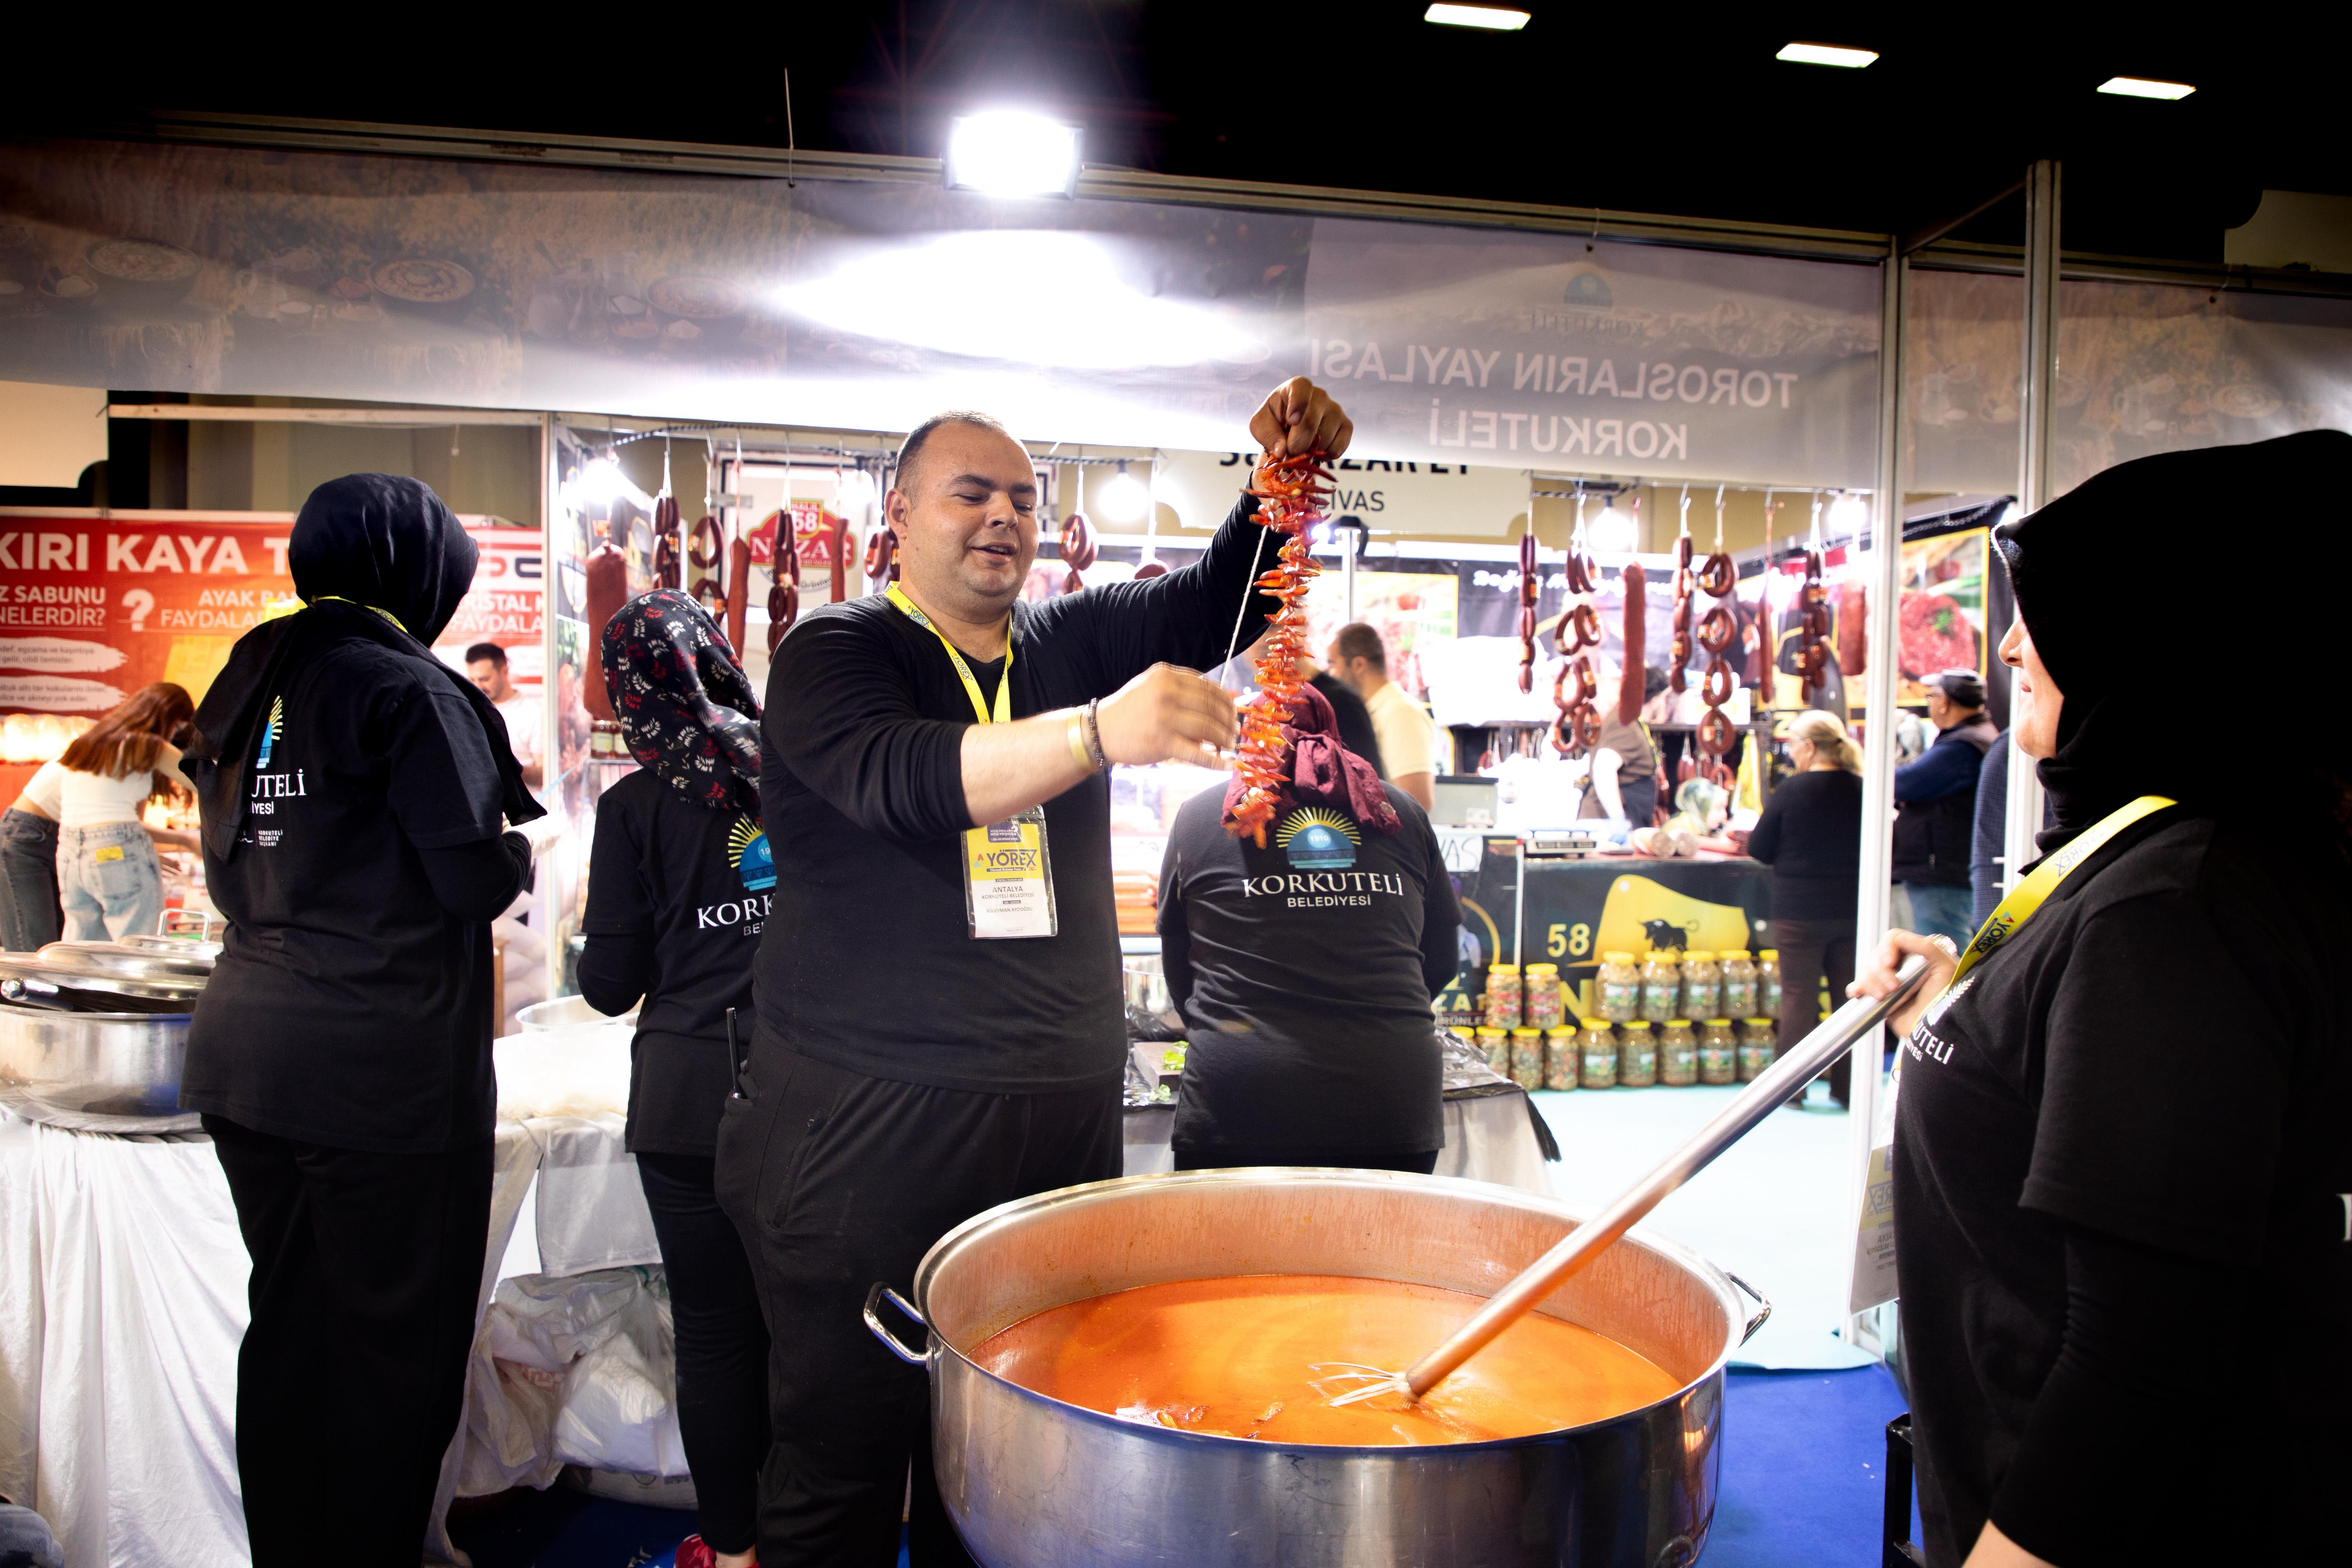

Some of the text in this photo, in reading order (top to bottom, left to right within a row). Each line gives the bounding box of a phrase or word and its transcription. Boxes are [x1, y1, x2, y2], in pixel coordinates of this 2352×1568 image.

[106, 534, 249, 574] KAYA
[14, 585, 106, 604] SABUNU
[198, 589, 255, 607] AYAK
[986, 849, 1037, 868] YÖREX
[1241, 872, 1404, 898] KORKUTELİ
[1287, 894, 1371, 908] BELEDİYESİ
[1547, 923, 1591, 958] 58
